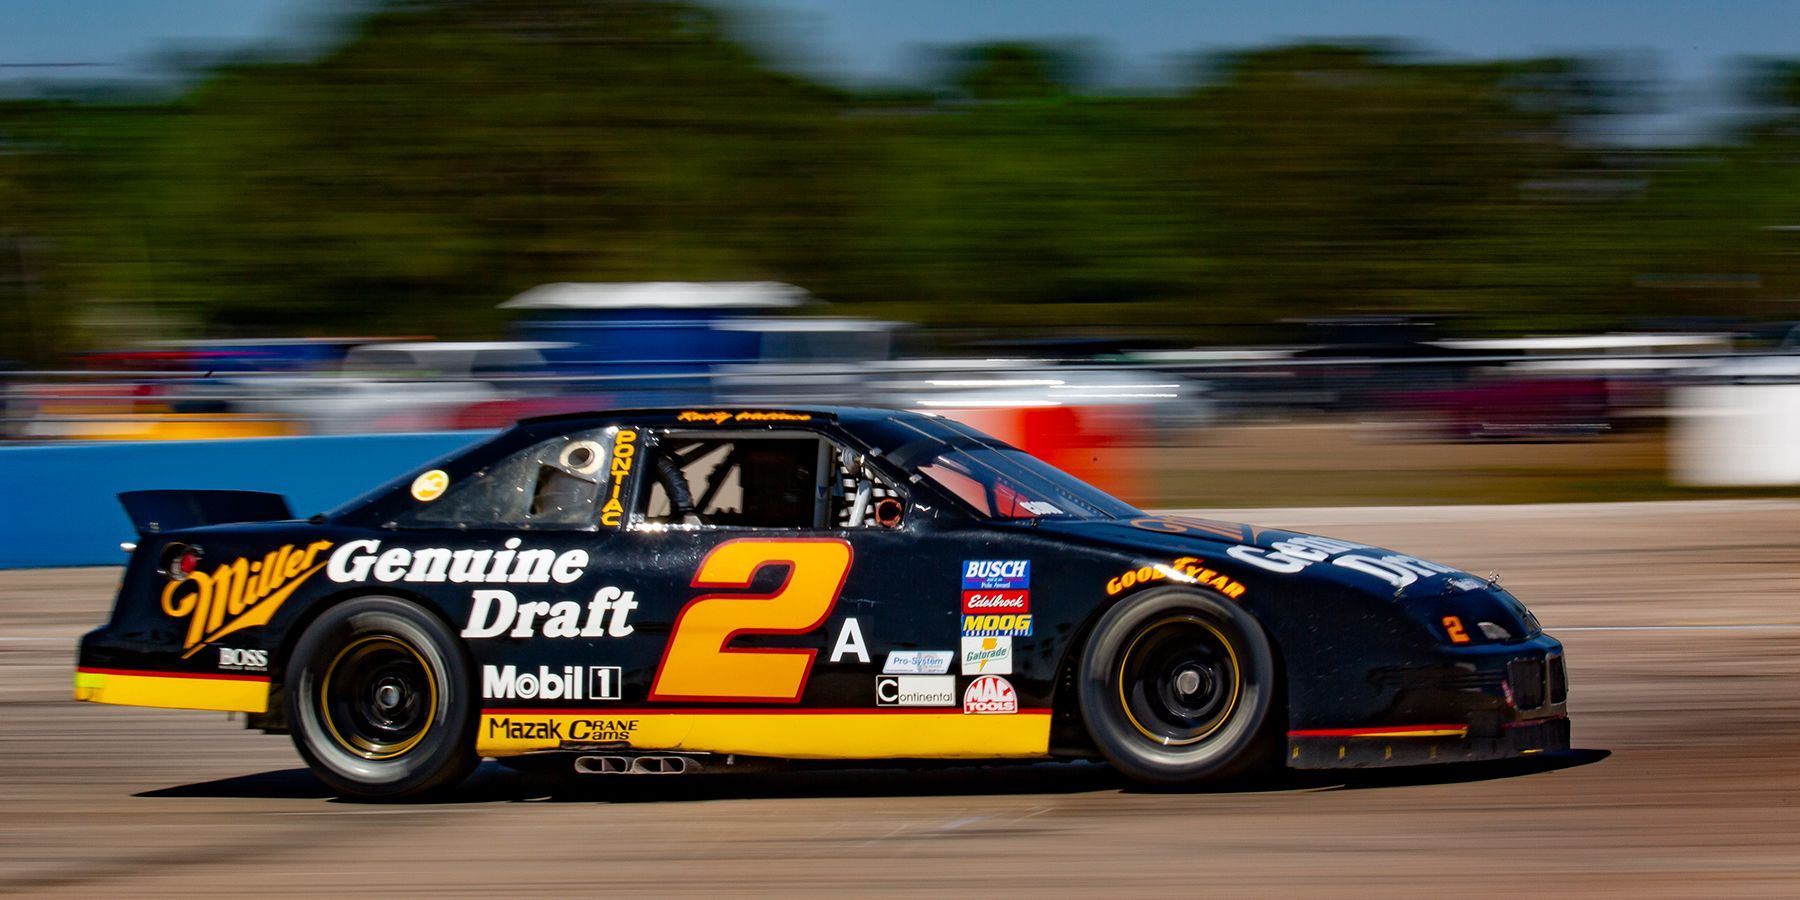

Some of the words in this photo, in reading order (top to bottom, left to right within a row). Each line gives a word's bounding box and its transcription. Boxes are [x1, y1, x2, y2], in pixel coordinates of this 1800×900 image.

[602, 430, 637, 526] PONTIAC
[326, 537, 590, 584] Genuine
[965, 560, 1028, 578] BUSCH
[1106, 557, 1246, 599] GOODYEAR
[161, 539, 334, 649] Miller
[967, 593, 1025, 609] Edelbrock
[461, 586, 639, 639] Draft
[648, 537, 855, 703] 2
[963, 615, 1033, 631] MOOG
[829, 617, 871, 663] A
[1442, 615, 1471, 643] 2
[219, 648, 268, 667] BOSS
[893, 656, 944, 666] Pro-System
[966, 646, 1008, 662] Gatorade
[483, 665, 583, 699] Mobil
[878, 679, 953, 702] Continental
[967, 677, 1013, 702] MAC
[966, 702, 1014, 712] TOOLS
[490, 718, 563, 740] Mazak
